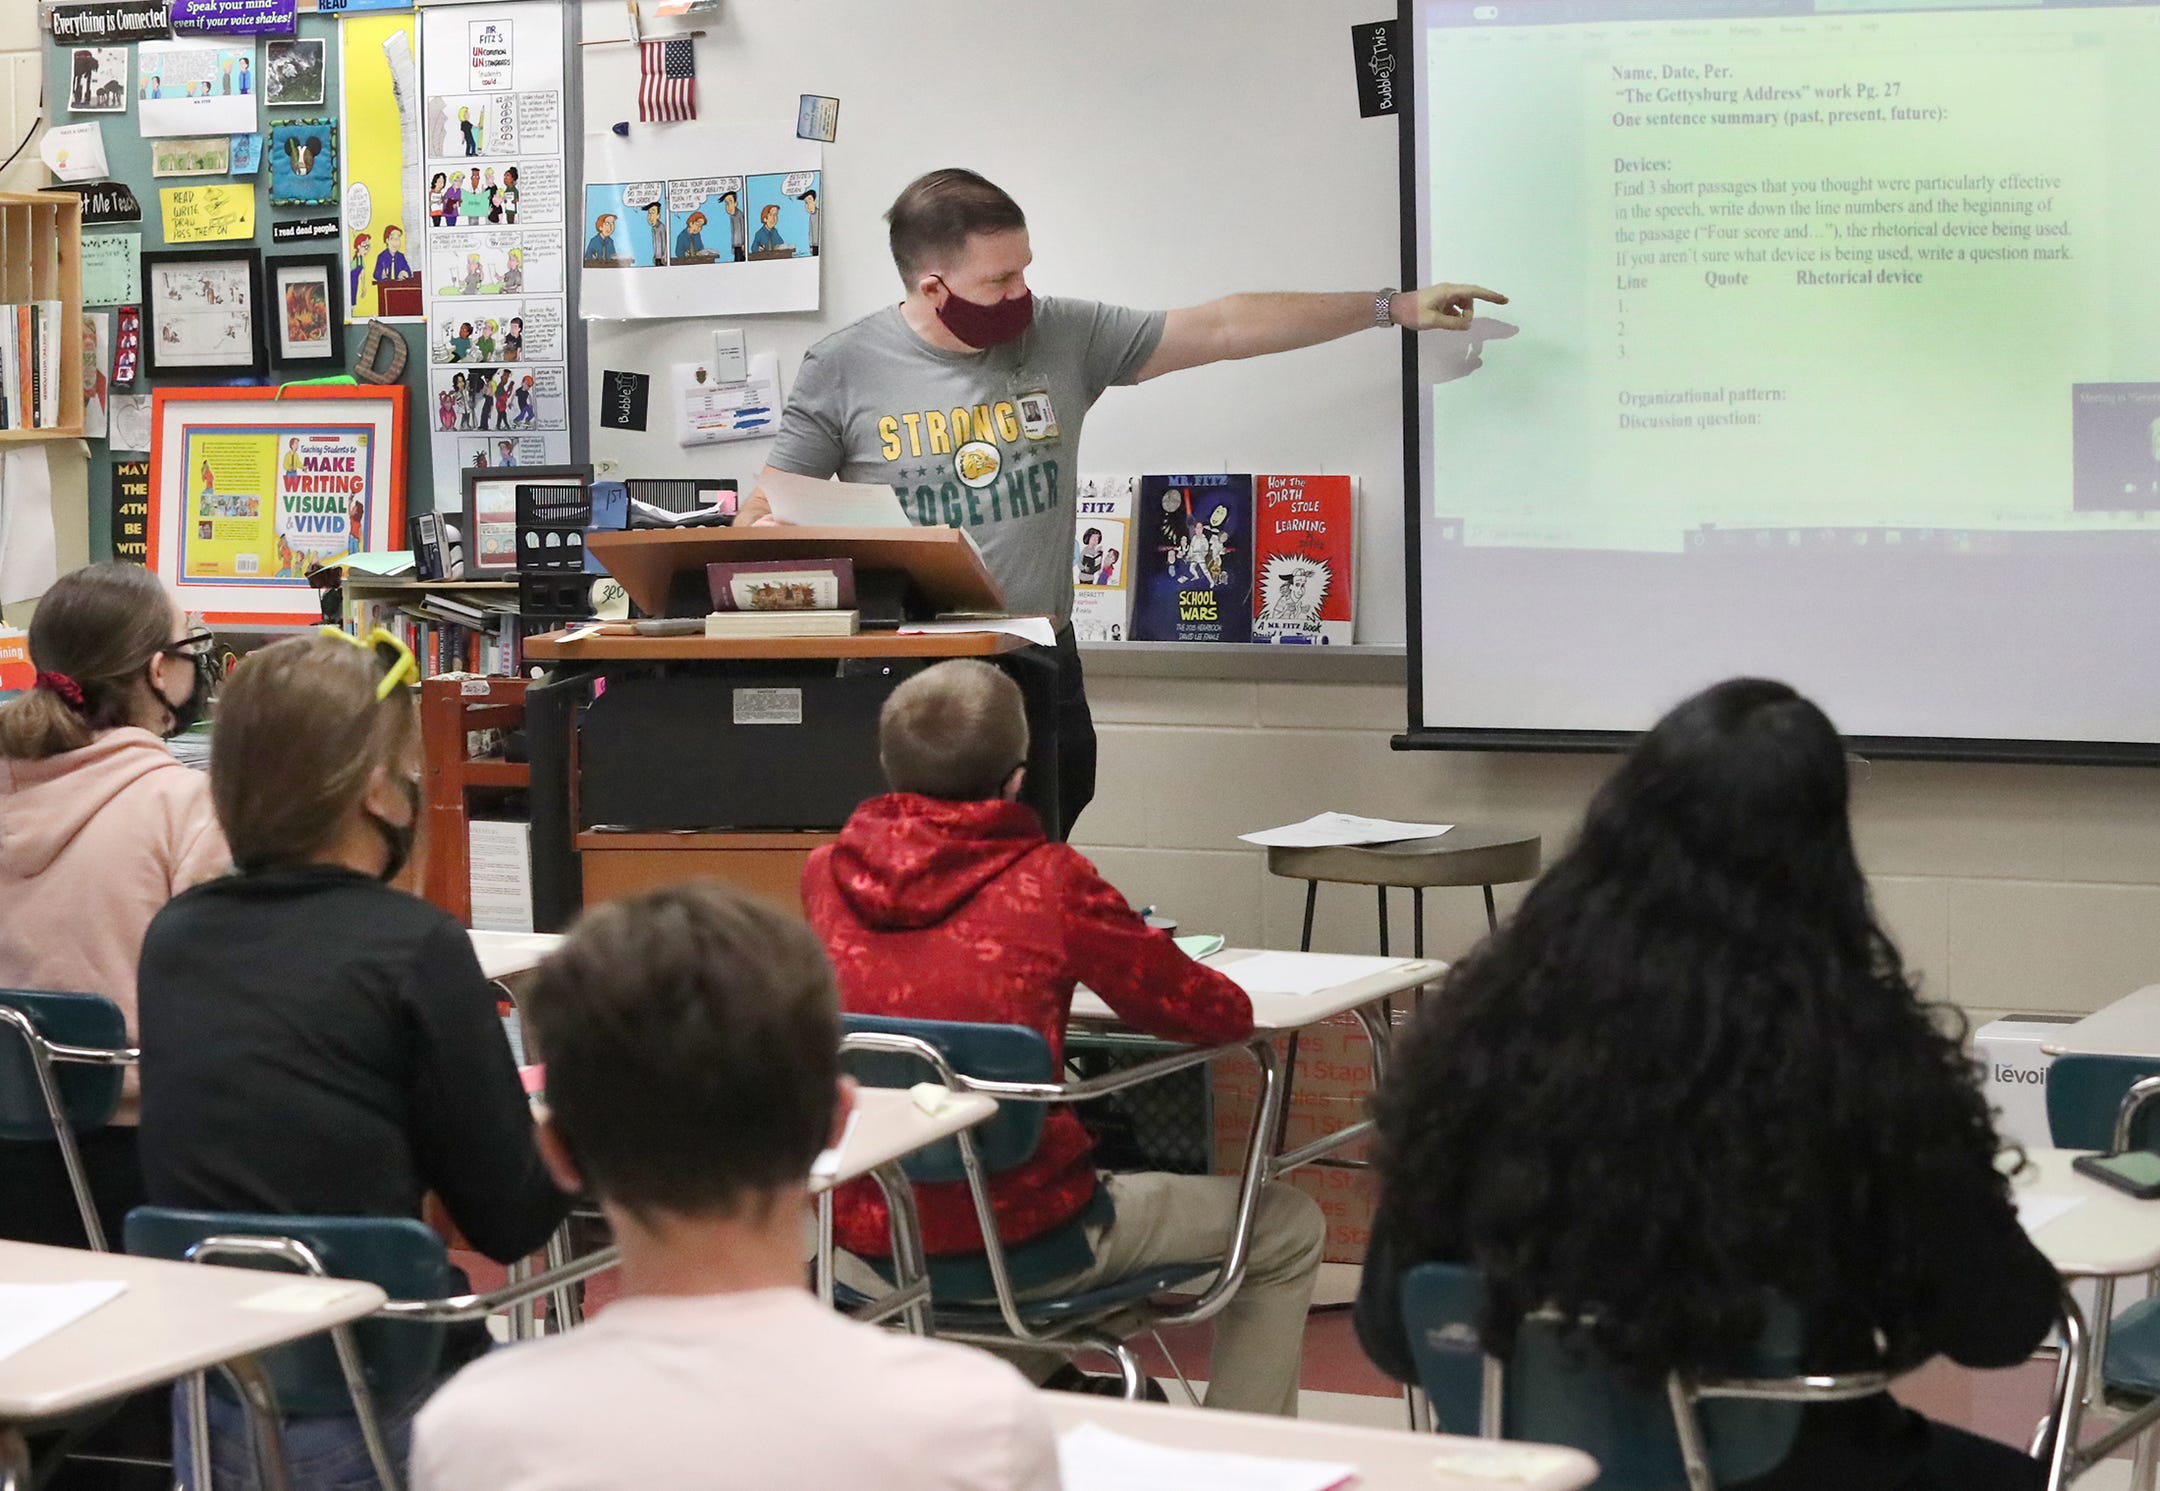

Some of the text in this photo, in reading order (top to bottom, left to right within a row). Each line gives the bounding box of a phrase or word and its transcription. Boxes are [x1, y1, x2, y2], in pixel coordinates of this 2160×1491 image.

[186, 0, 217, 15] Speak
[218, 1, 244, 13] your
[318, 0, 348, 10] READ
[53, 6, 168, 36] Everything is Connected
[173, 11, 292, 32] even if your voice shakes!
[1371, 27, 1388, 55] This
[1611, 63, 1734, 82] Name, Date, Per.
[1375, 70, 1393, 110] Bubble
[1655, 86, 1738, 105] Gettysburg
[1814, 83, 1851, 99] work
[1856, 83, 1880, 100] Pg.
[1883, 81, 1902, 98] 27
[1611, 104, 1950, 128] One sentence summary (past, present, future):
[1613, 157, 1672, 174] Devices:
[1613, 172, 2062, 198] Find 3 short passages that you thought were particularly effective
[92, 192, 110, 213] Me
[173, 190, 195, 204] READ
[172, 203, 200, 218] WRITE
[1614, 196, 2055, 221] in the speech, write down the line numbers and the beginning of
[194, 226, 208, 237] THE
[216, 225, 229, 235] ON
[274, 221, 339, 238] I read dead people.
[1614, 226, 1636, 244] the
[1638, 227, 1691, 245] passage
[1742, 224, 1781, 240] score
[1846, 221, 1868, 239] the
[1871, 221, 1939, 238] rhetorical
[1941, 220, 1989, 238] device
[1991, 219, 2032, 240] being
[2034, 219, 2073, 237] used.
[1615, 250, 1628, 267] If
[1630, 252, 1656, 270] you
[1701, 250, 1731, 263] sure
[1733, 246, 1768, 263] what
[1770, 246, 1817, 263] device
[1819, 246, 1832, 262] is
[1835, 245, 1874, 264] being
[1876, 244, 1914, 262] used,
[1916, 244, 1955, 262] write
[1957, 249, 1966, 261] a
[1969, 244, 2030, 264] question
[2032, 243, 2075, 261] mark.
[1617, 268, 1924, 291] Line Quote Rhetorical device
[617, 388, 633, 424] Bubble
[1617, 386, 1787, 408] Organizational pattern:
[1618, 411, 1762, 431] Discussion question:
[877, 400, 1020, 463] STRONG
[323, 445, 350, 454] Students
[118, 464, 149, 477] MAY
[303, 456, 356, 473] MAKE
[121, 483, 148, 496] THE
[282, 475, 364, 494] WRITING
[1168, 475, 1229, 487] MR. FITZ
[895, 458, 1060, 529] TOGETHER
[1265, 488, 1303, 509] DIRTH
[119, 502, 148, 516] 4TH
[282, 495, 347, 514] VISUAL
[1290, 500, 1320, 513] STOLE
[124, 522, 142, 536] BE
[294, 515, 346, 533] VIVID
[1274, 518, 1327, 535] LEARNING
[116, 542, 149, 555] WITH
[1178, 590, 1217, 606] SCHOOL
[1180, 606, 1218, 621] WARS
[1257, 621, 1266, 631] A
[1282, 622, 1301, 630] FITZ
